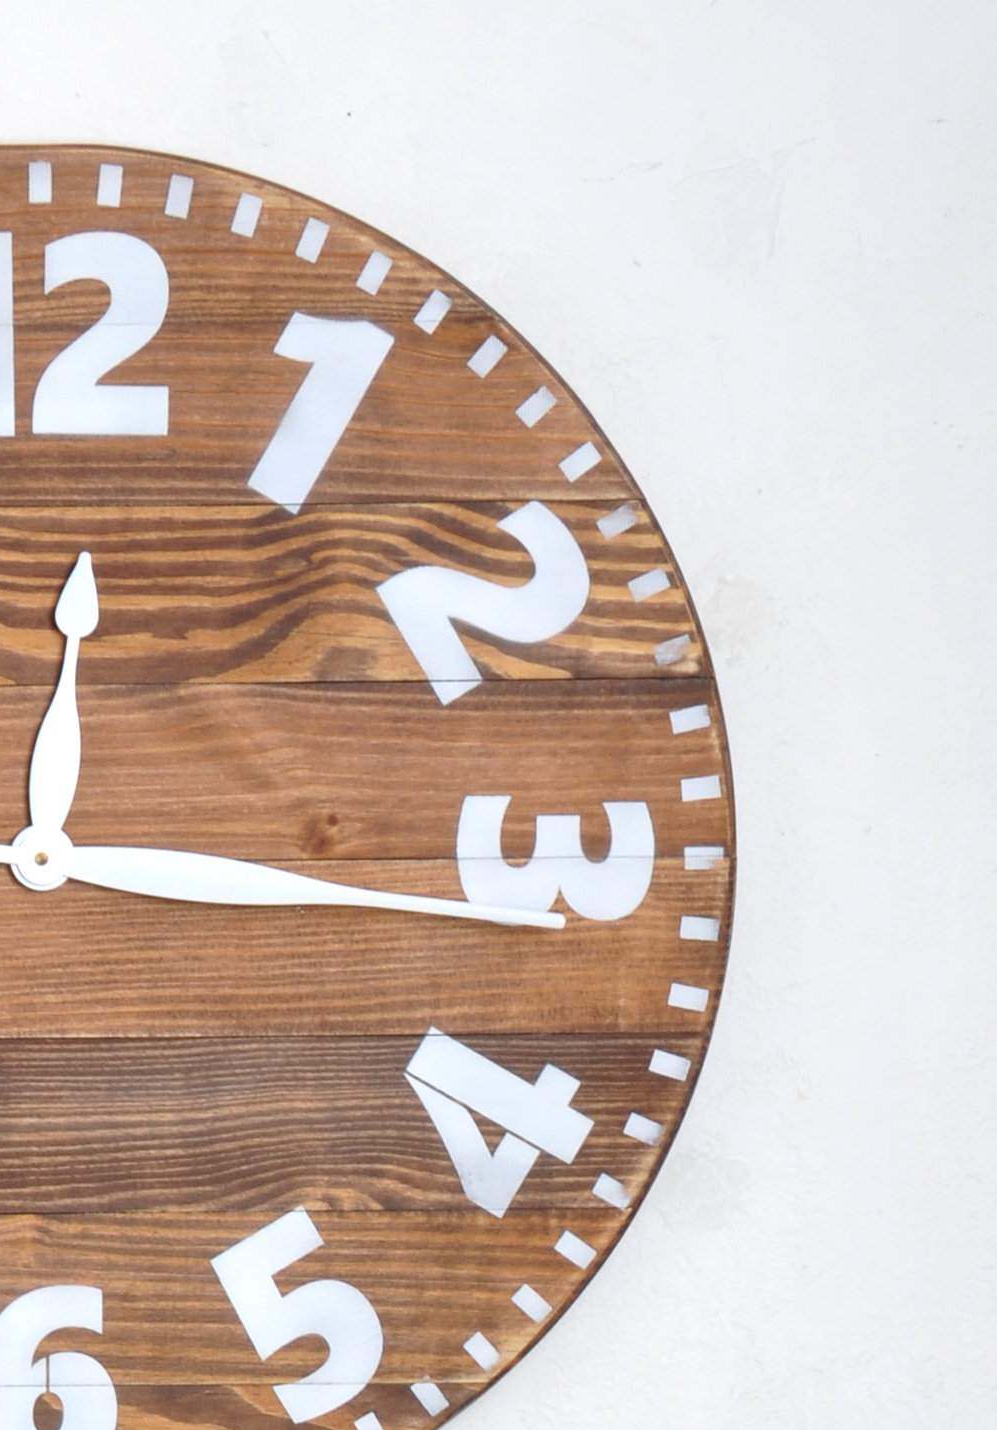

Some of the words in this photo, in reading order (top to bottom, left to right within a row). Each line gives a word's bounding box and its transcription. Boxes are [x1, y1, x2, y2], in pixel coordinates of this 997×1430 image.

[247, 310, 396, 515] 1
[376, 497, 591, 706] 2
[456, 795, 656, 926] 3
[404, 1026, 595, 1219] 4
[209, 1204, 385, 1425] 5
